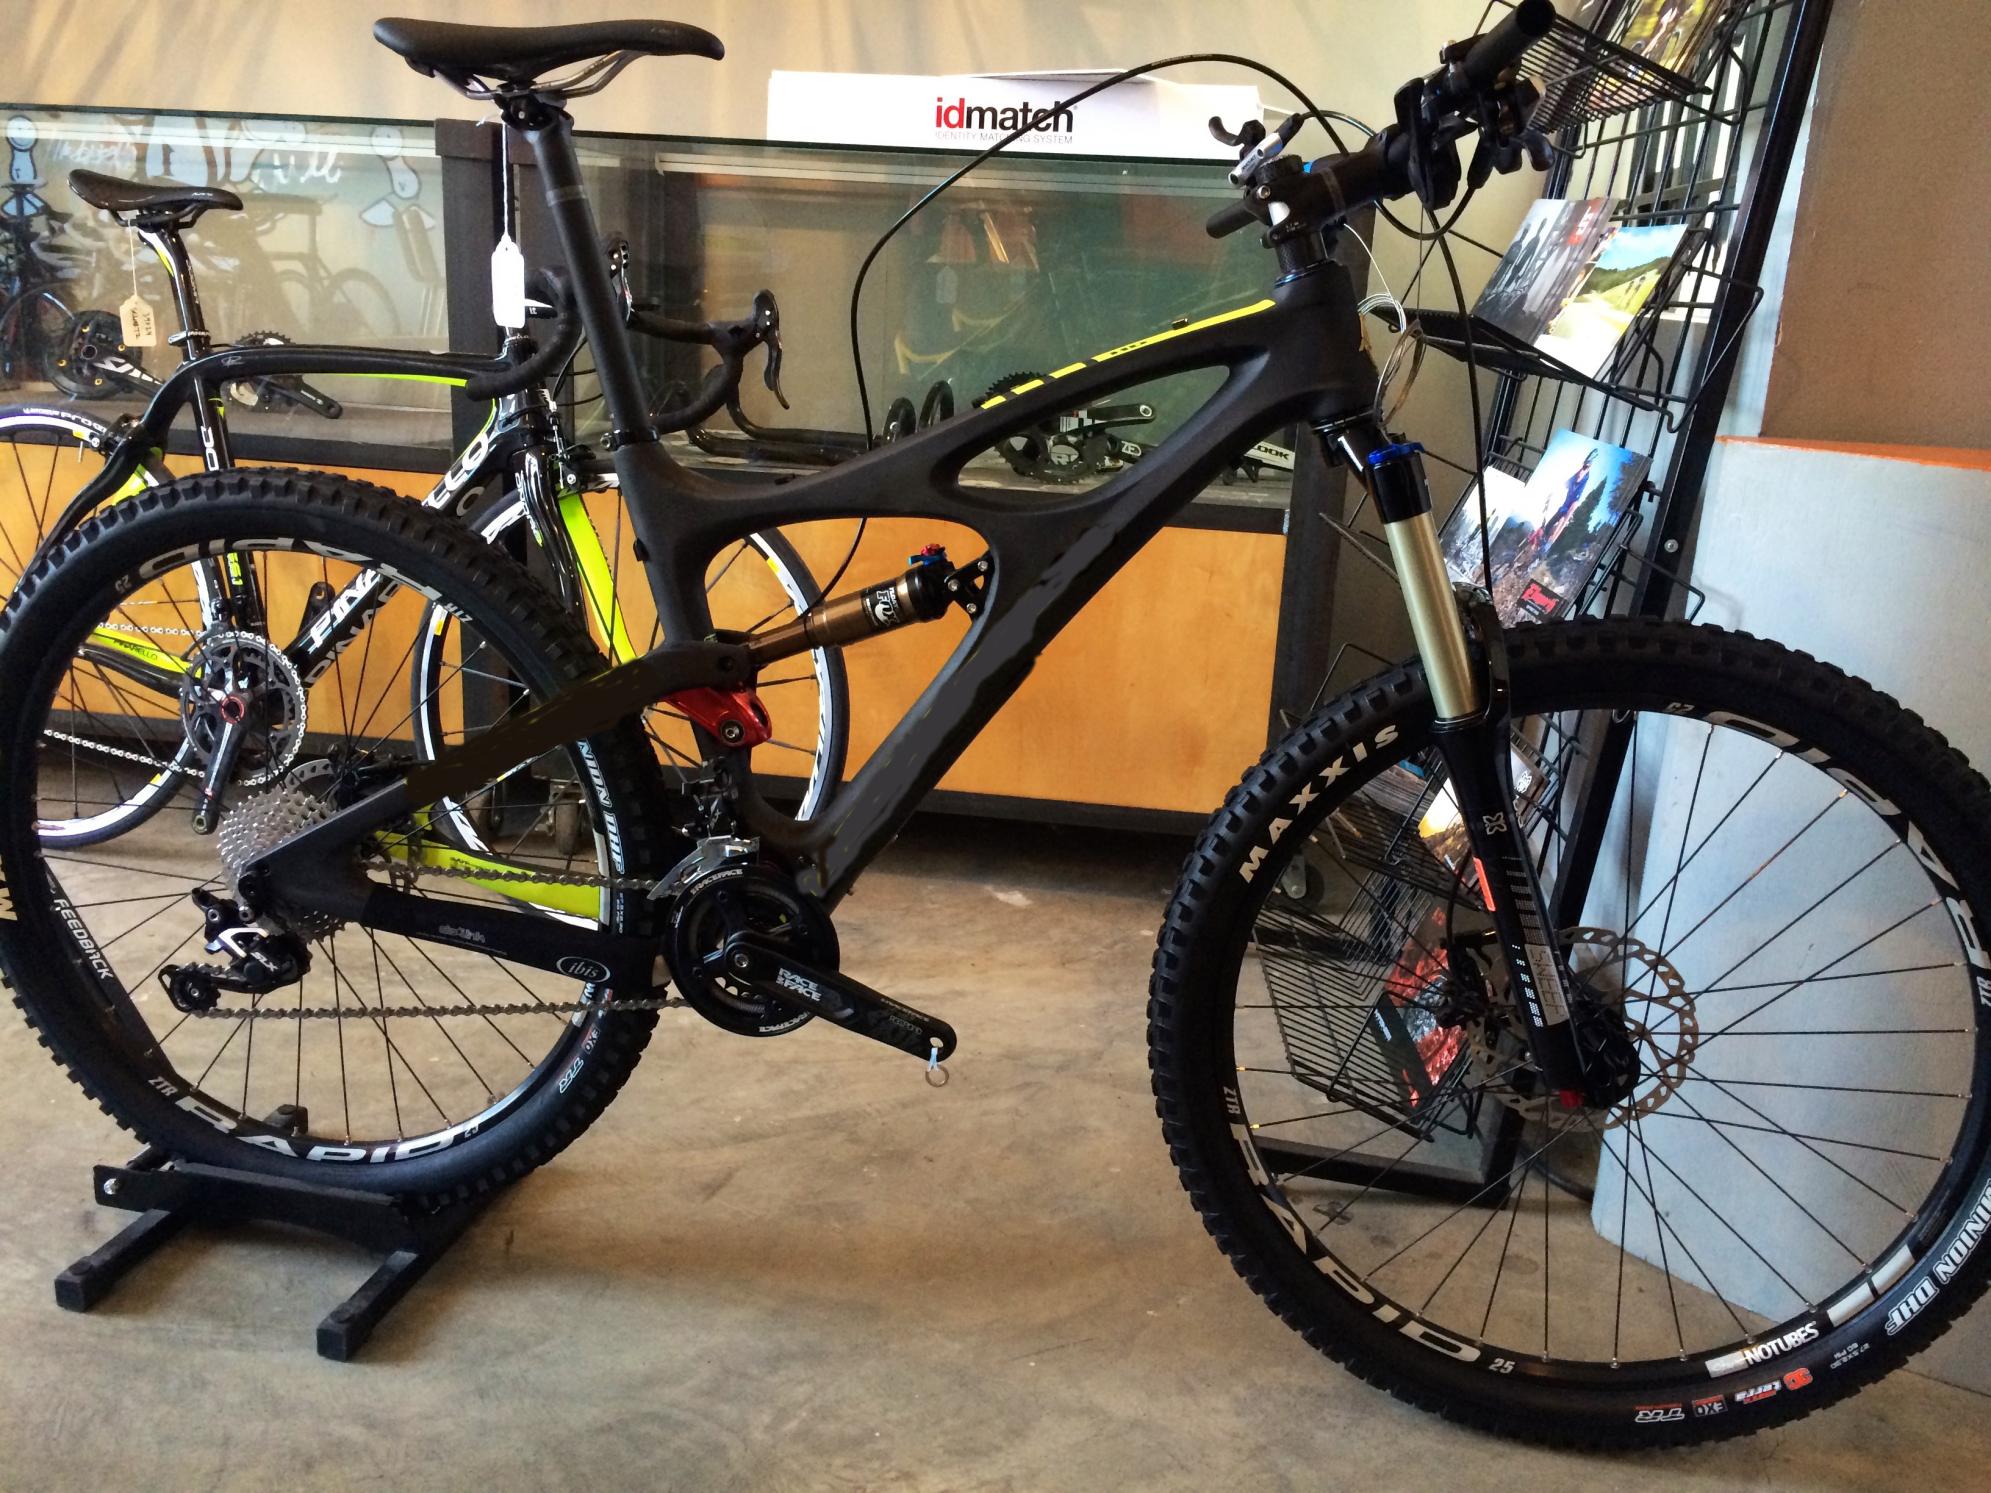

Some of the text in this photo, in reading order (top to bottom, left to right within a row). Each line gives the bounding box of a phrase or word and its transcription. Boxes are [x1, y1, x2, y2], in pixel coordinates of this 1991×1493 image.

[935, 97, 1074, 133] idmatch
[979, 132, 1031, 144] MATNG
[1033, 134, 1073, 145] SYSTEM
[445, 602, 474, 623] ZTR
[1239, 725, 1399, 883] MAXXIS
[603, 810, 625, 875] DHF
[1703, 711, 1990, 969] RAPID
[569, 961, 599, 978] ibis
[778, 967, 819, 990] RACE
[148, 1076, 179, 1097] ZTR
[1223, 1085, 1241, 1115] ZTR
[174, 1095, 465, 1163] RAPID
[1231, 1123, 1481, 1363] RAPID
[1884, 1276, 1939, 1337] DHF
[1744, 1322, 1820, 1366] NOTUBES
[1488, 1358, 1515, 1374] 25
